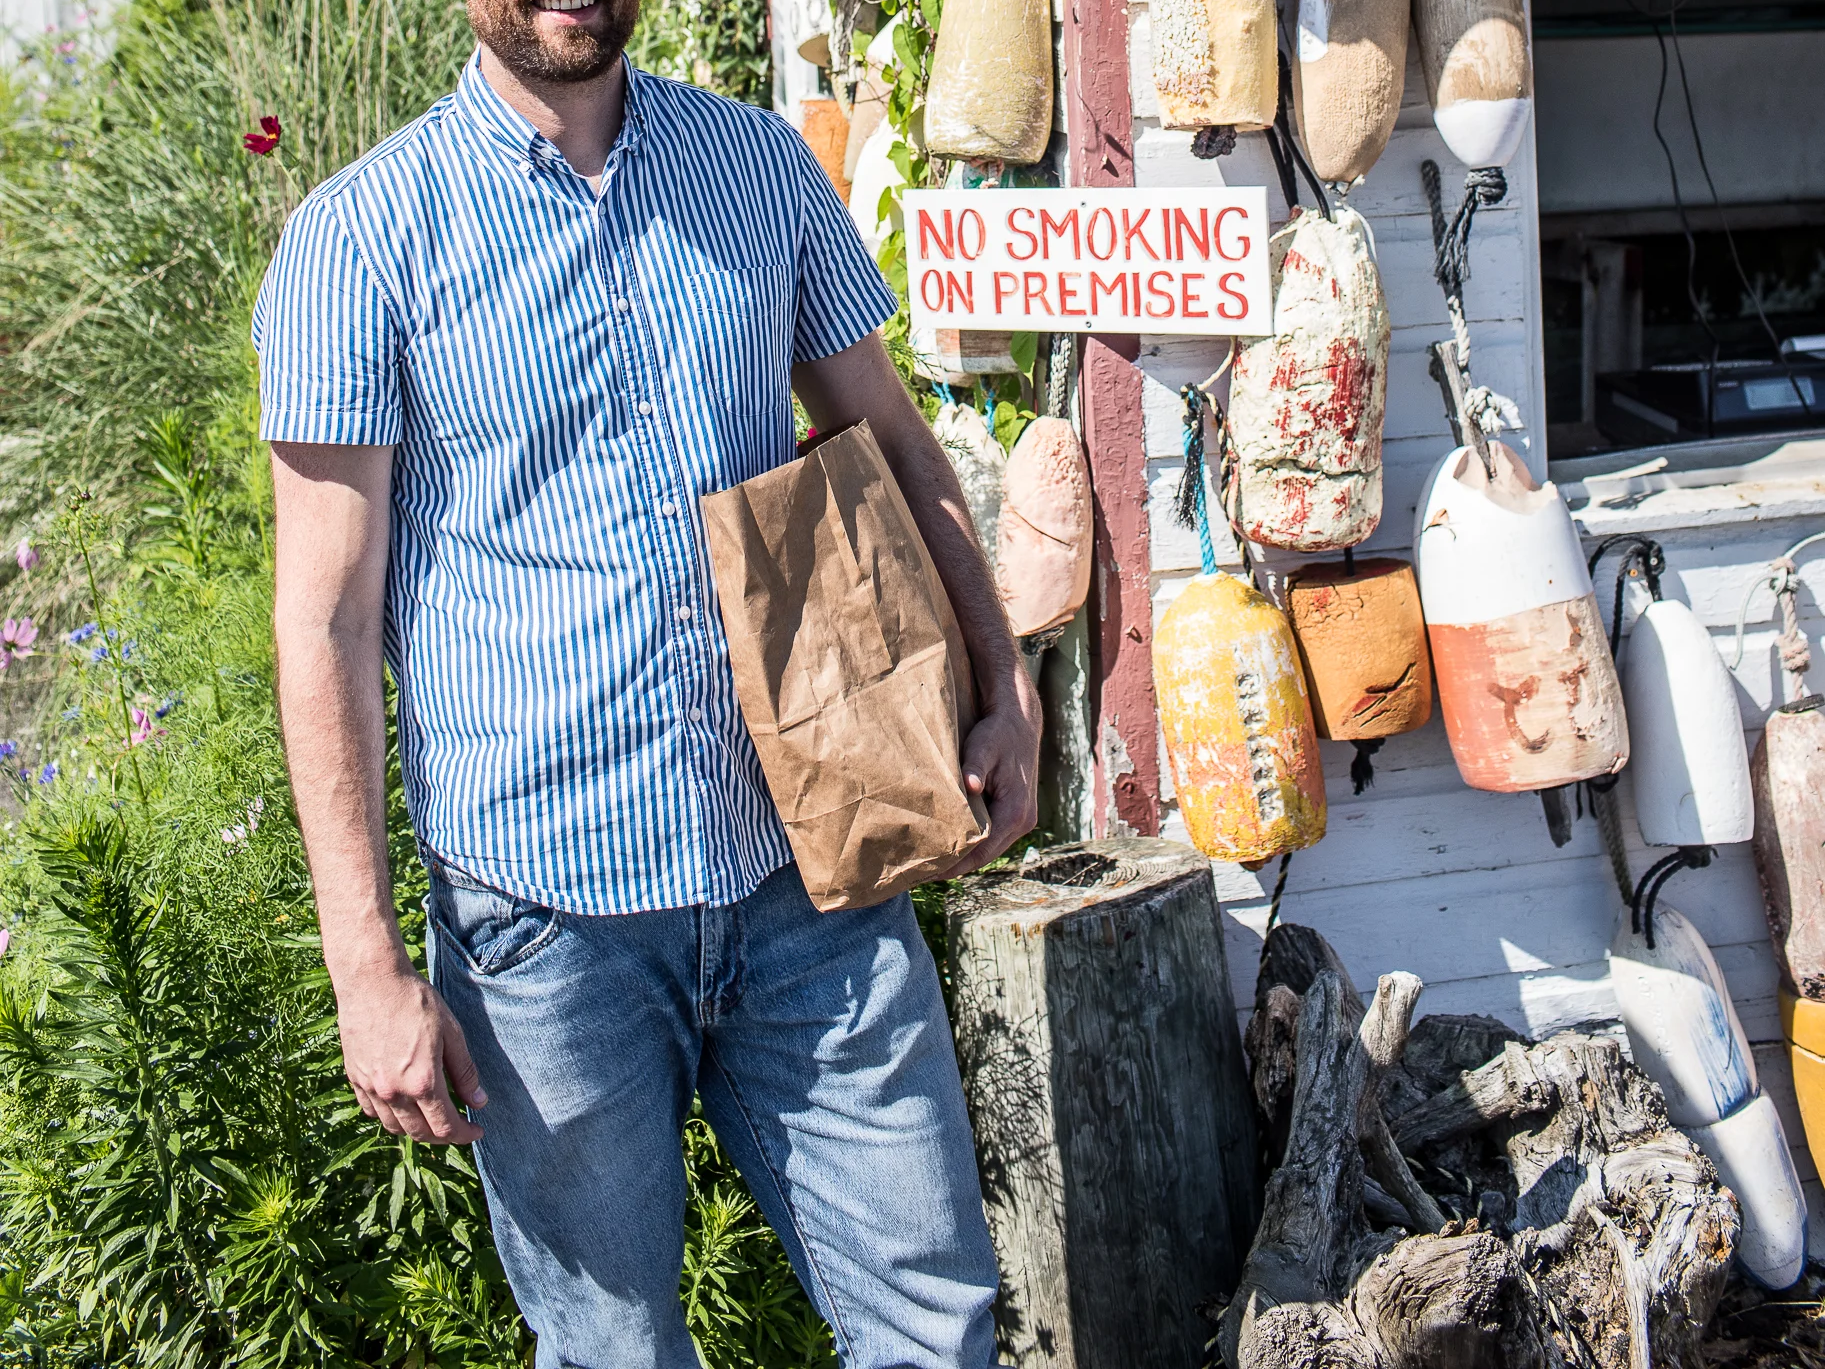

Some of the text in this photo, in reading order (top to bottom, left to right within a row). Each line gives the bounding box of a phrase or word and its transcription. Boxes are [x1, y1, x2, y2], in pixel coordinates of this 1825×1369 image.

[917, 206, 1252, 261] NO SMOKING
[920, 269, 1250, 321] ON PREMISES
